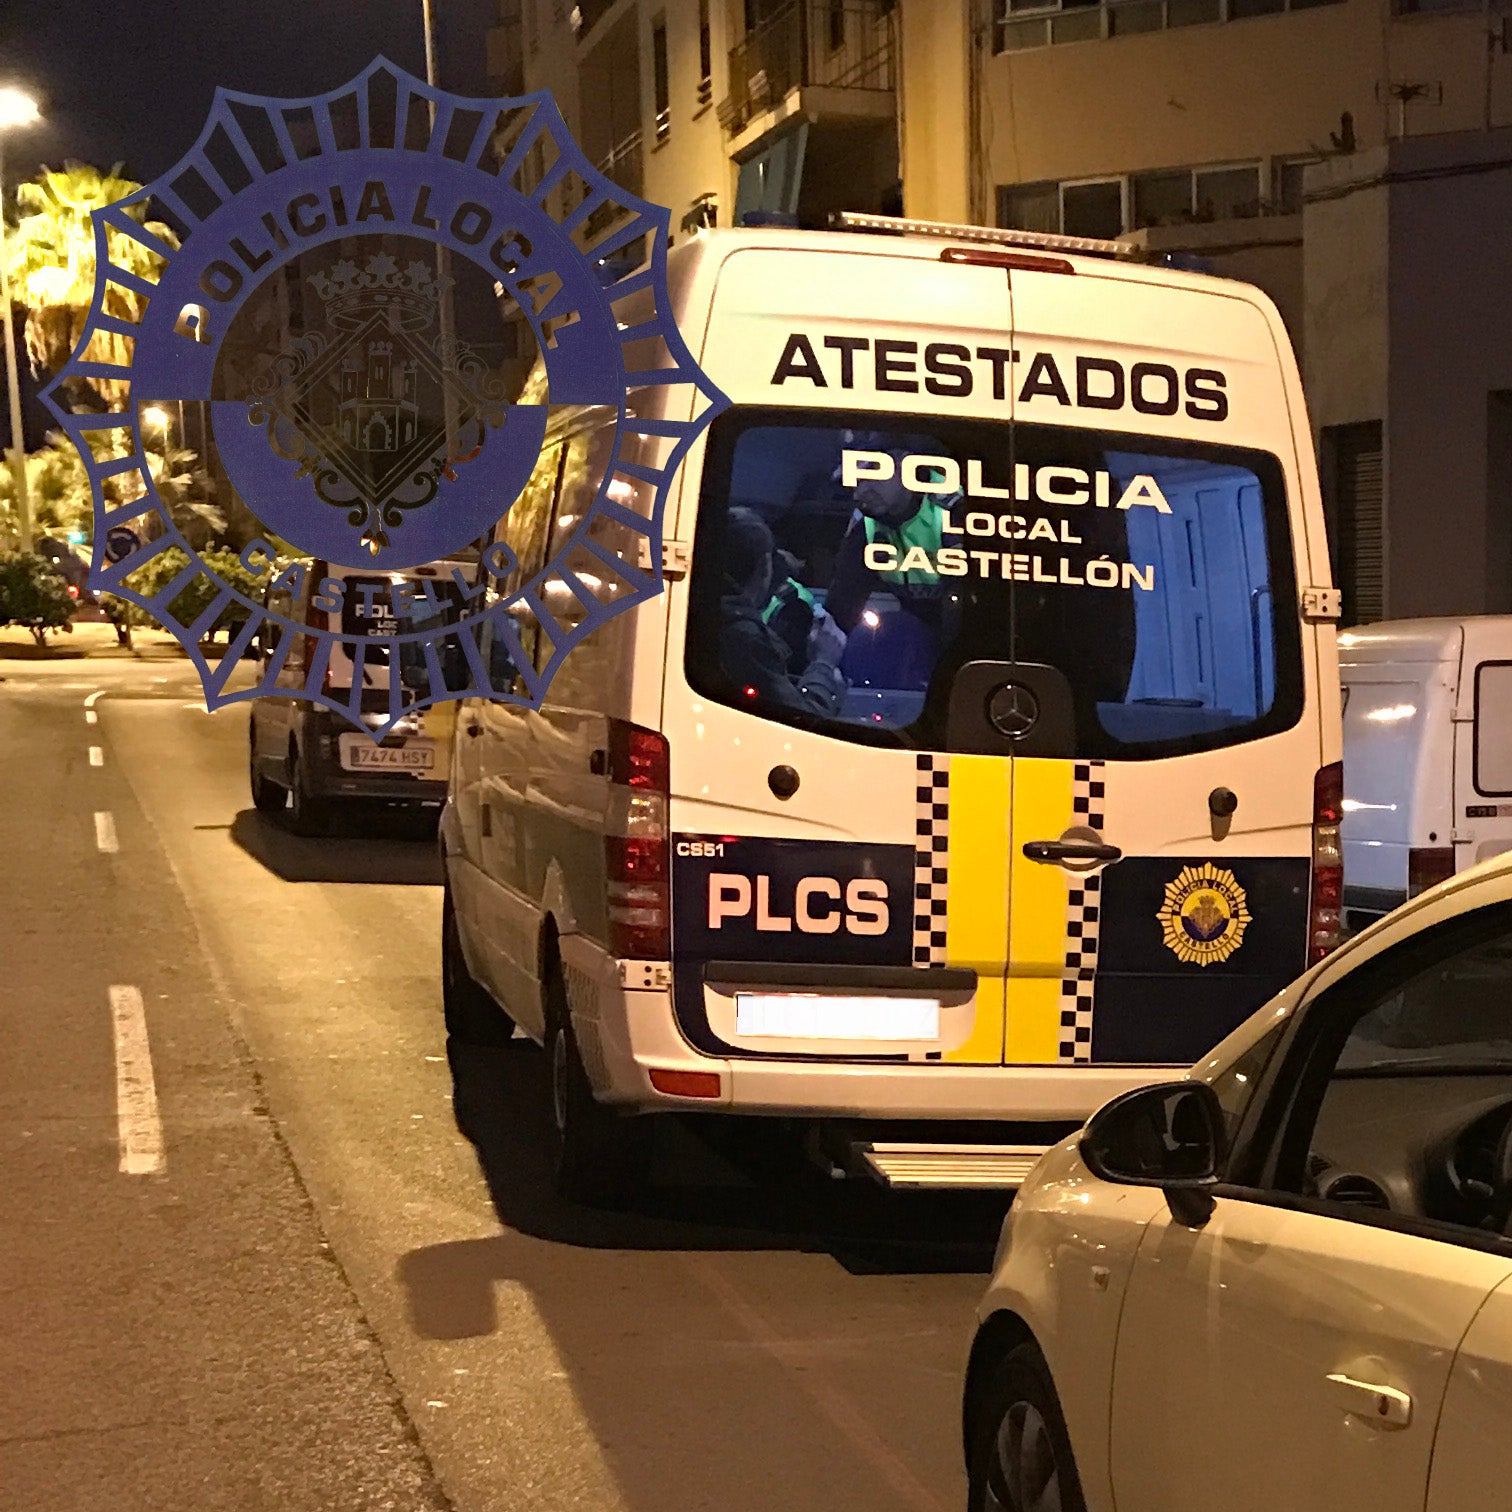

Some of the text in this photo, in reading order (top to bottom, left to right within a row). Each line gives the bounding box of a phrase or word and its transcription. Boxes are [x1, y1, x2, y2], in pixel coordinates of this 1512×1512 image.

[770, 333, 1229, 422] ATESTADOS
[841, 449, 1173, 514] POLICIA
[941, 509, 1083, 545] LOCAL
[863, 543, 1155, 591] CASTELLÓN
[676, 842, 725, 858] CS51
[708, 872, 890, 936] PLCS
[1172, 880, 1238, 913] POLICIA LOCAL
